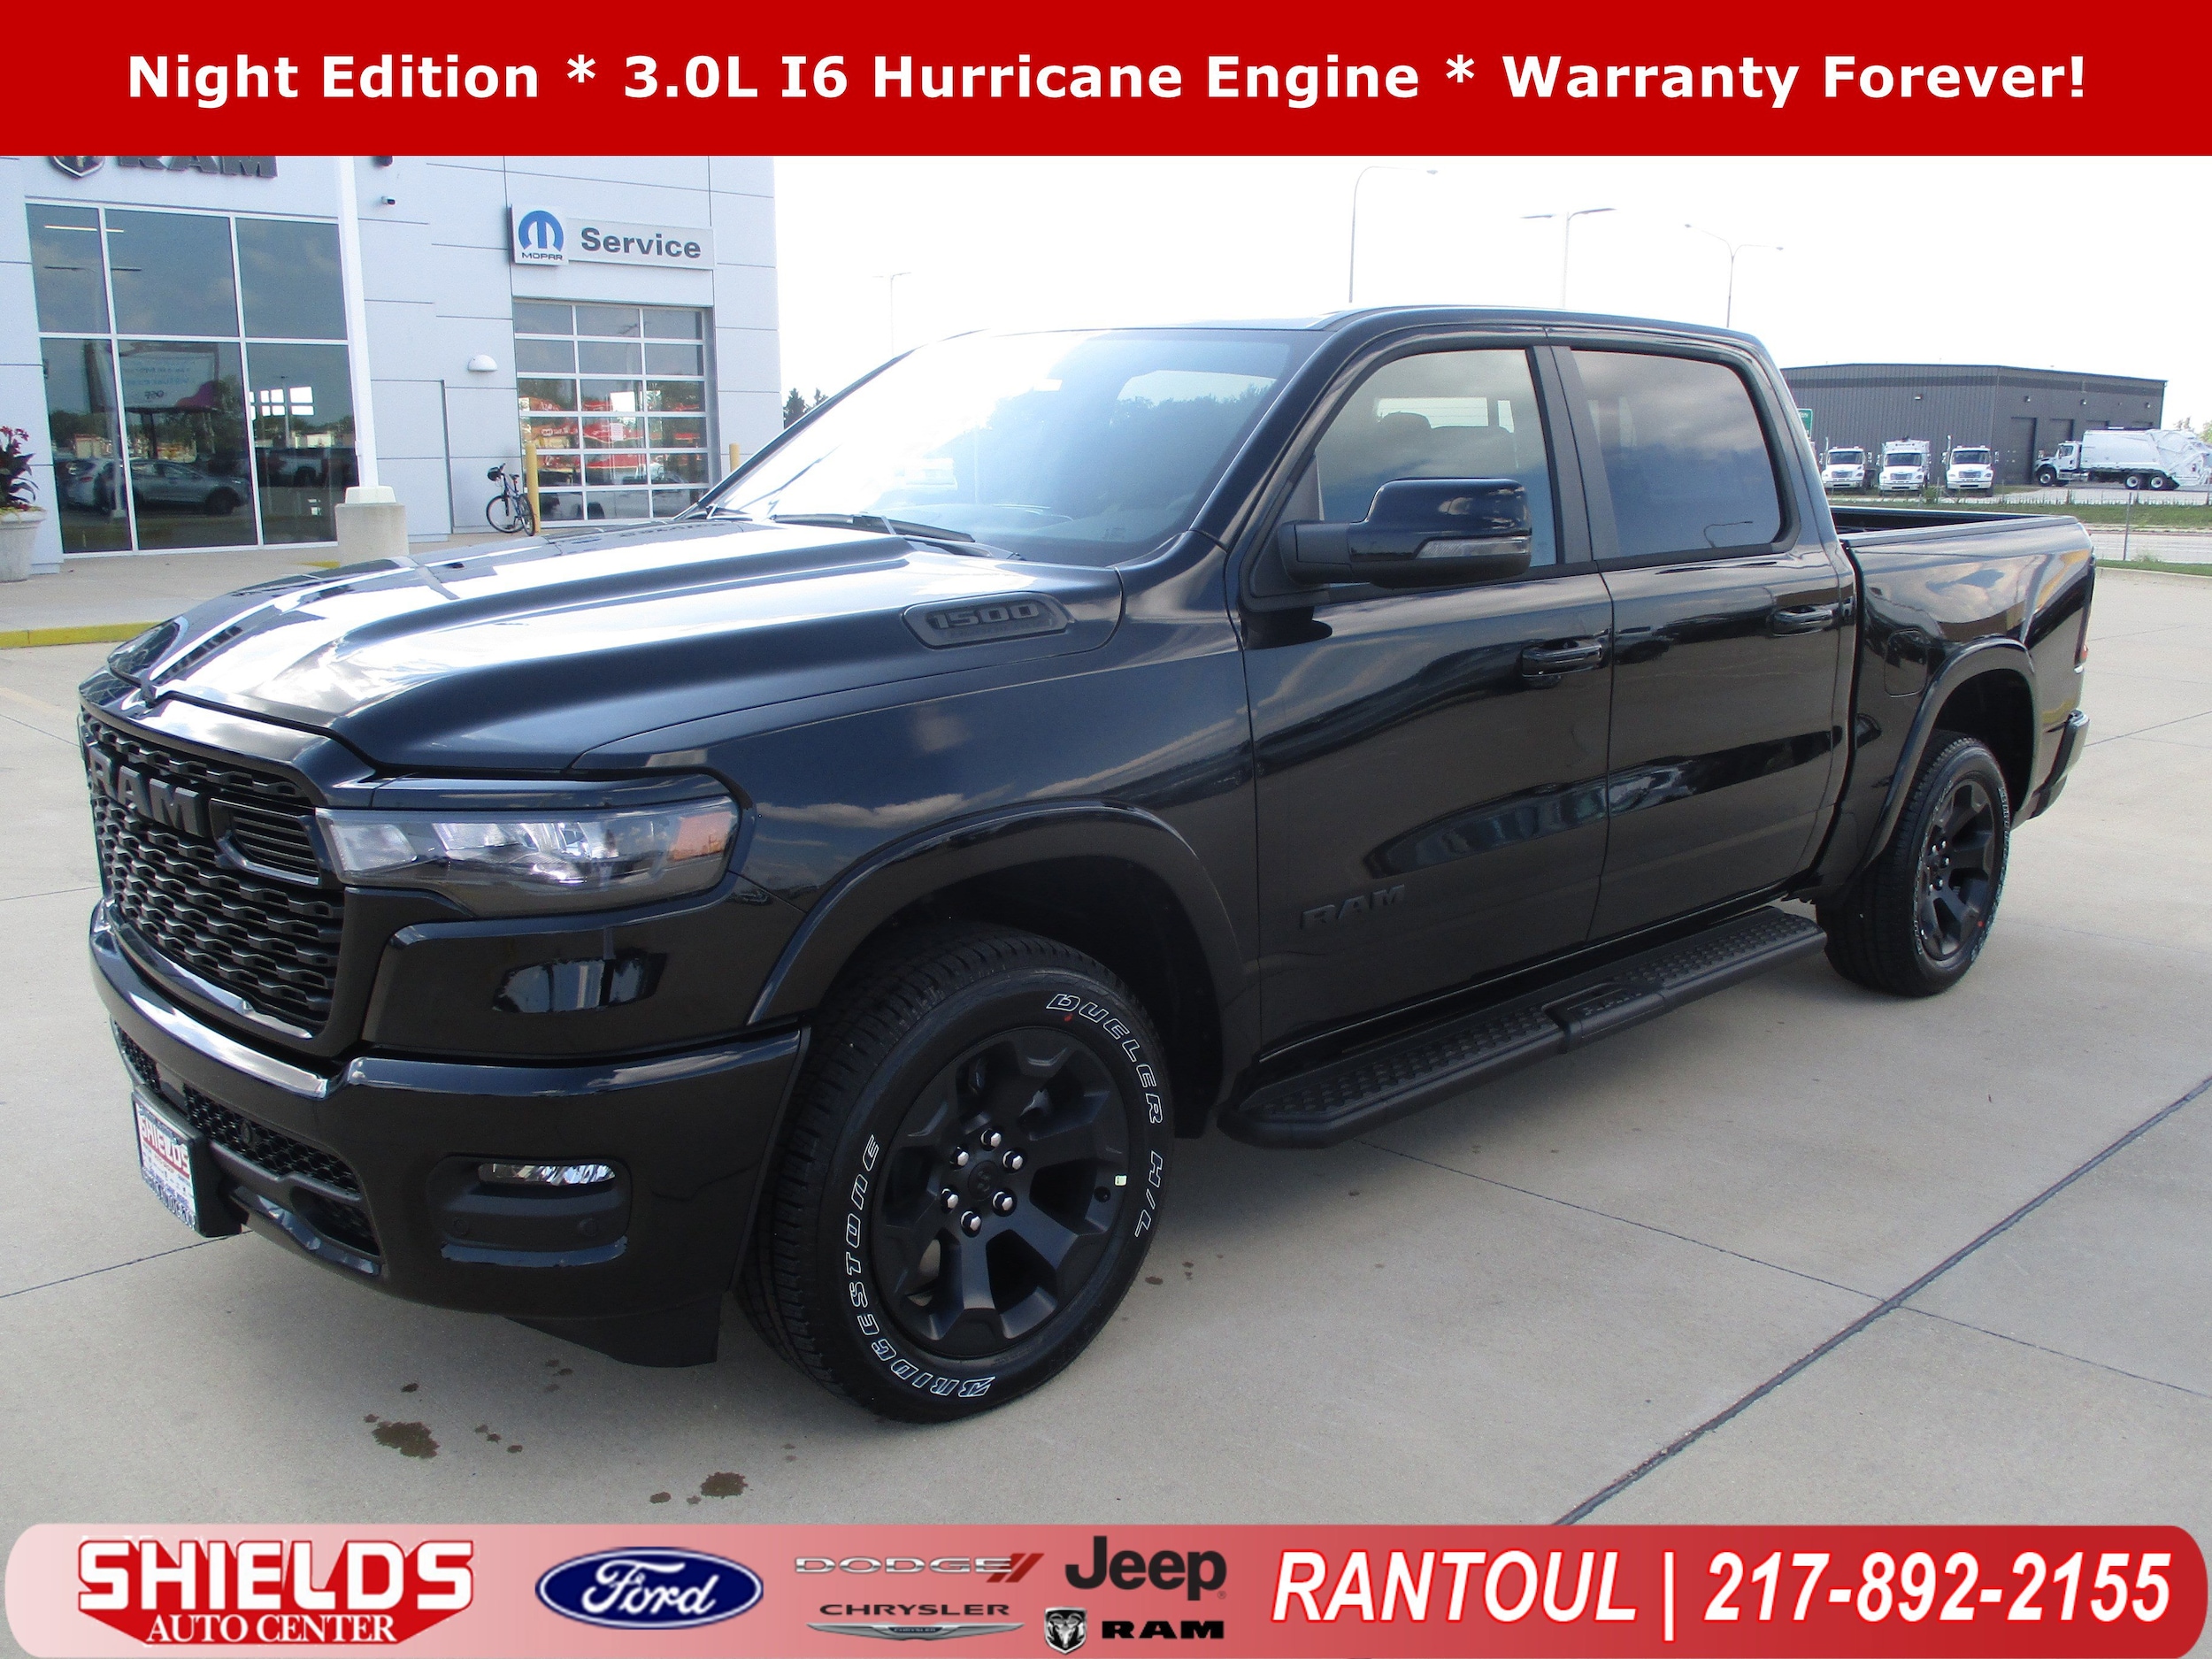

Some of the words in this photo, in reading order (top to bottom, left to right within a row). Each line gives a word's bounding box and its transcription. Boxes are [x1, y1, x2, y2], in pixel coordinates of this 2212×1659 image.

[521, 251, 564, 261] MOPAR
[580, 227, 702, 259] Service
[930, 603, 1040, 629] 1500
[88, 741, 206, 838] RAM
[1300, 883, 1406, 931] RAM
[1046, 993, 1164, 1125] DUELER
[139, 1116, 190, 1170] SHIELDS
[1134, 1150, 1164, 1238] H/L
[845, 1134, 996, 1398] BRIDGESTONE
